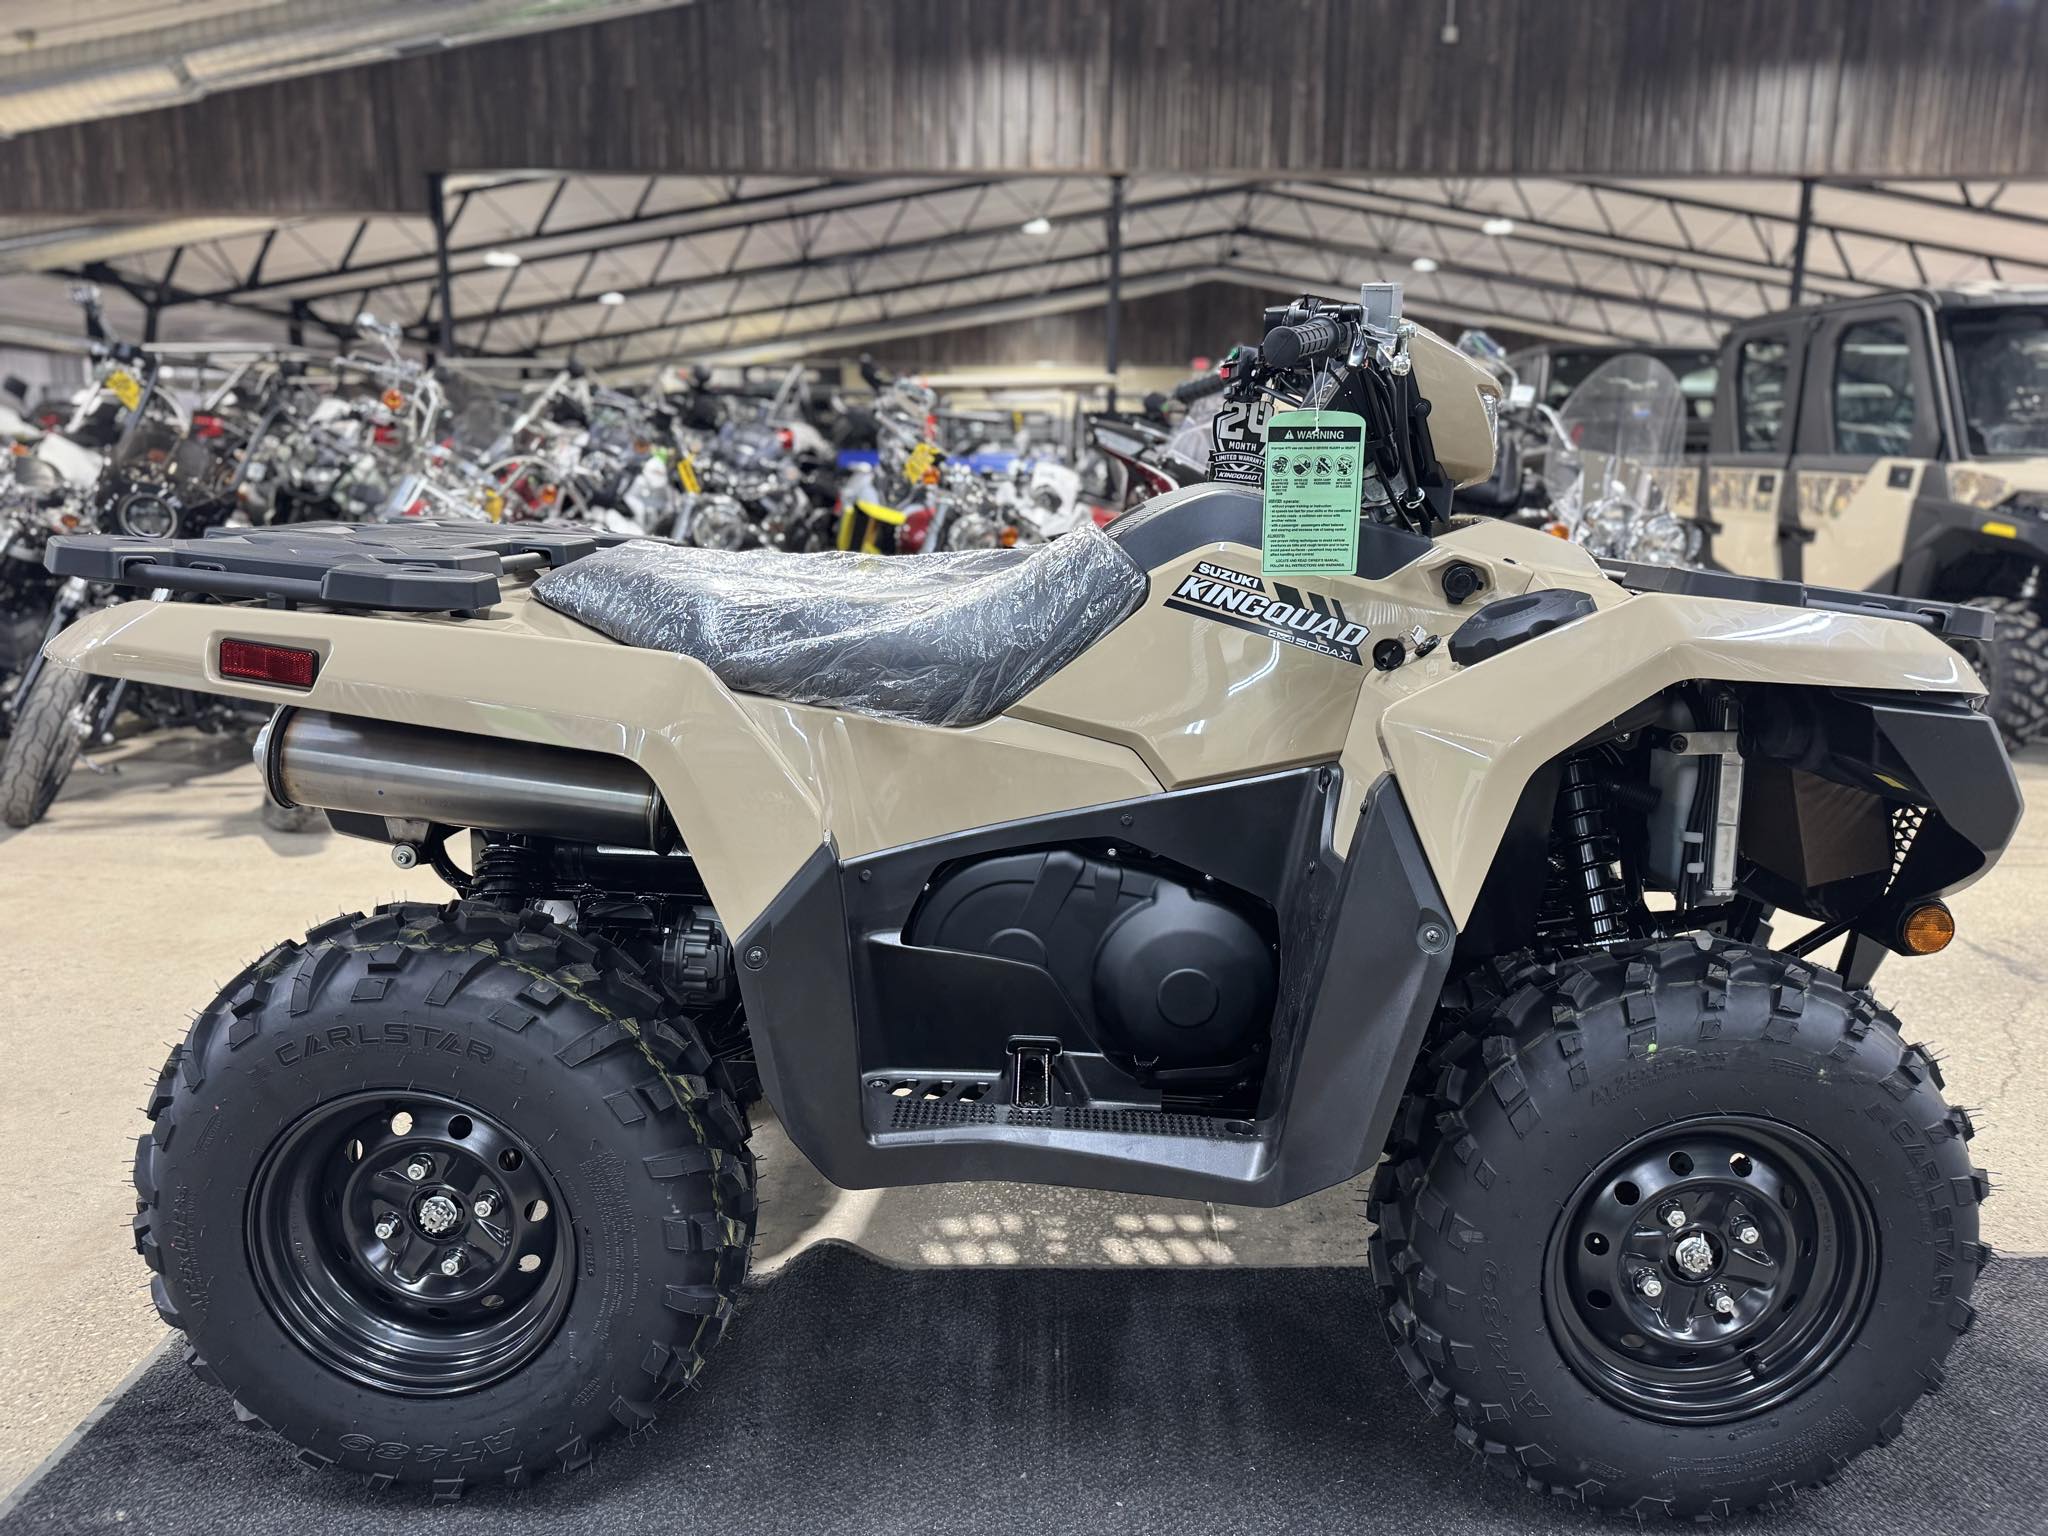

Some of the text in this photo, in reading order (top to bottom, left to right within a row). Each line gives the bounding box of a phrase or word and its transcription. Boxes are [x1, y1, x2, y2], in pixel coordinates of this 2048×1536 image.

[1219, 401, 1274, 442] 24
[1296, 430, 1344, 440] WARNING
[1228, 441, 1257, 452] MONTH
[1215, 454, 1266, 466] LIMITED WARRANTY
[1218, 471, 1258, 481] KINGQUAD
[1198, 563, 1258, 589] SUZUKI
[1177, 576, 1370, 646] KINGQUAD
[274, 1022, 496, 1068] CARLSTAR
